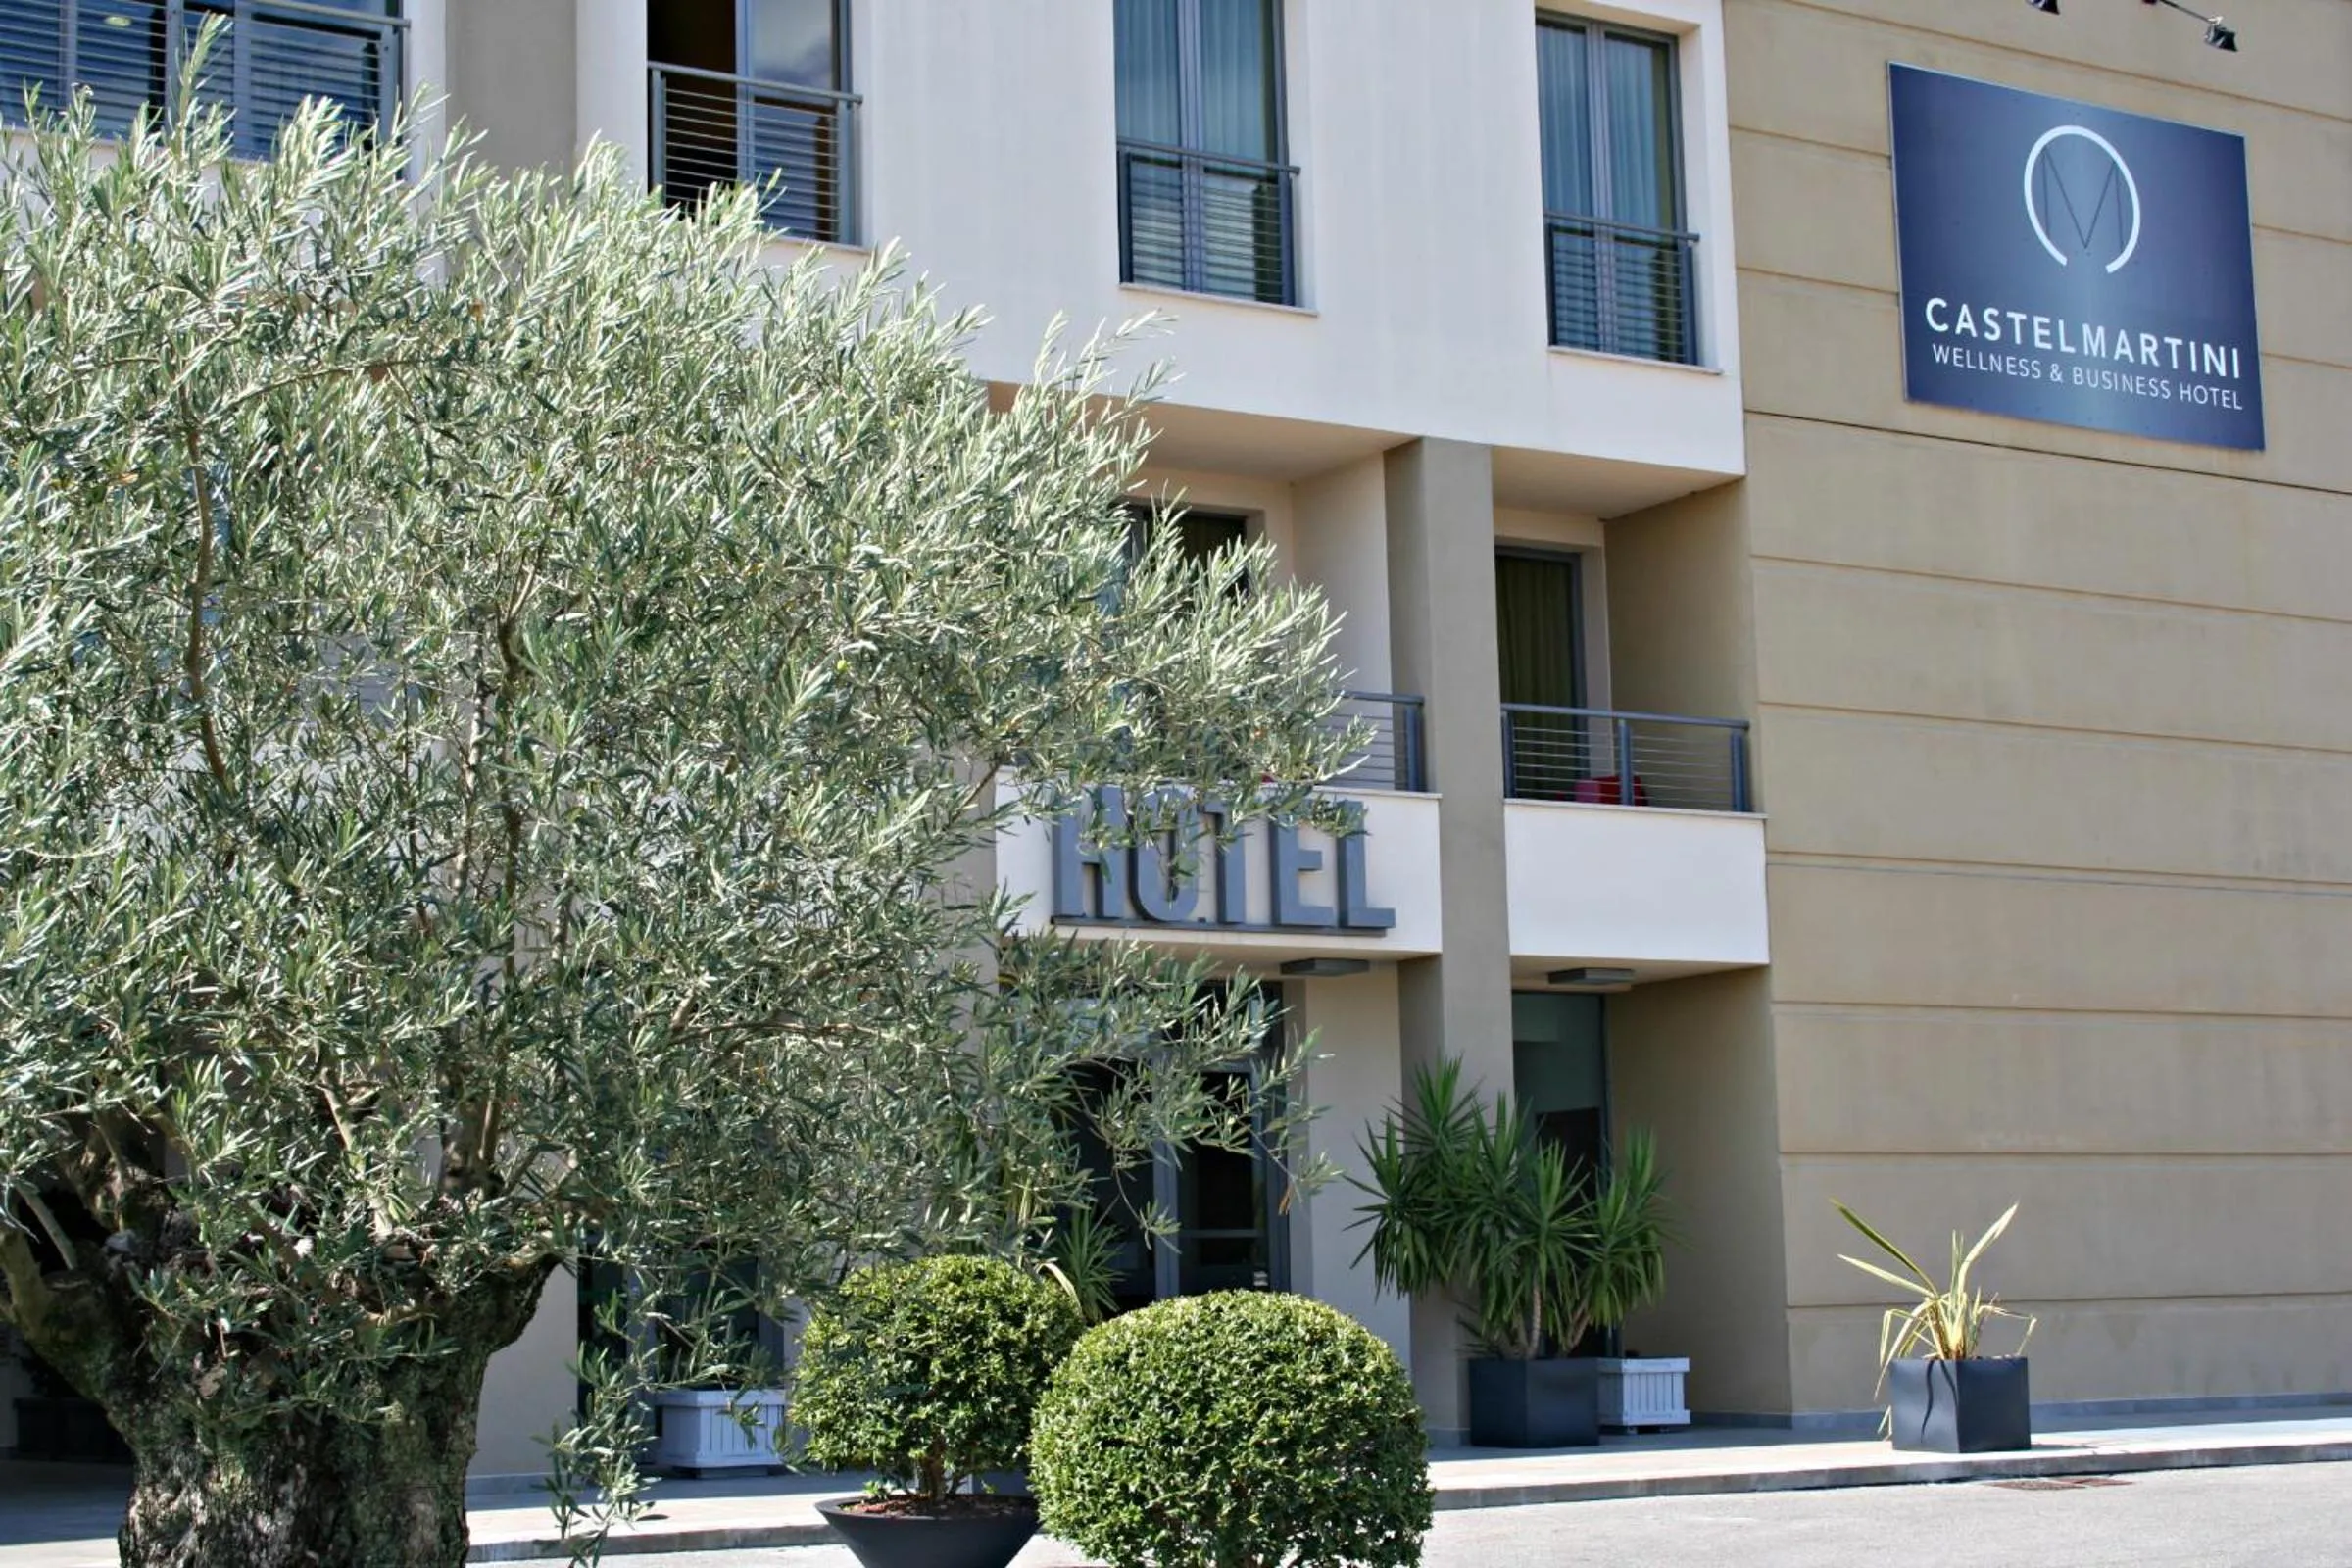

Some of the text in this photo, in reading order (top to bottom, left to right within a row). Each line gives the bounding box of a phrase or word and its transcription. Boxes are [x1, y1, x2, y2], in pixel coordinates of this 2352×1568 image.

[1925, 297, 2241, 379] CASTELMARTINI
[1932, 343, 2243, 410] WELLNESS & BUSINESS HOTEL
[1052, 783, 1396, 929] HOTEL
